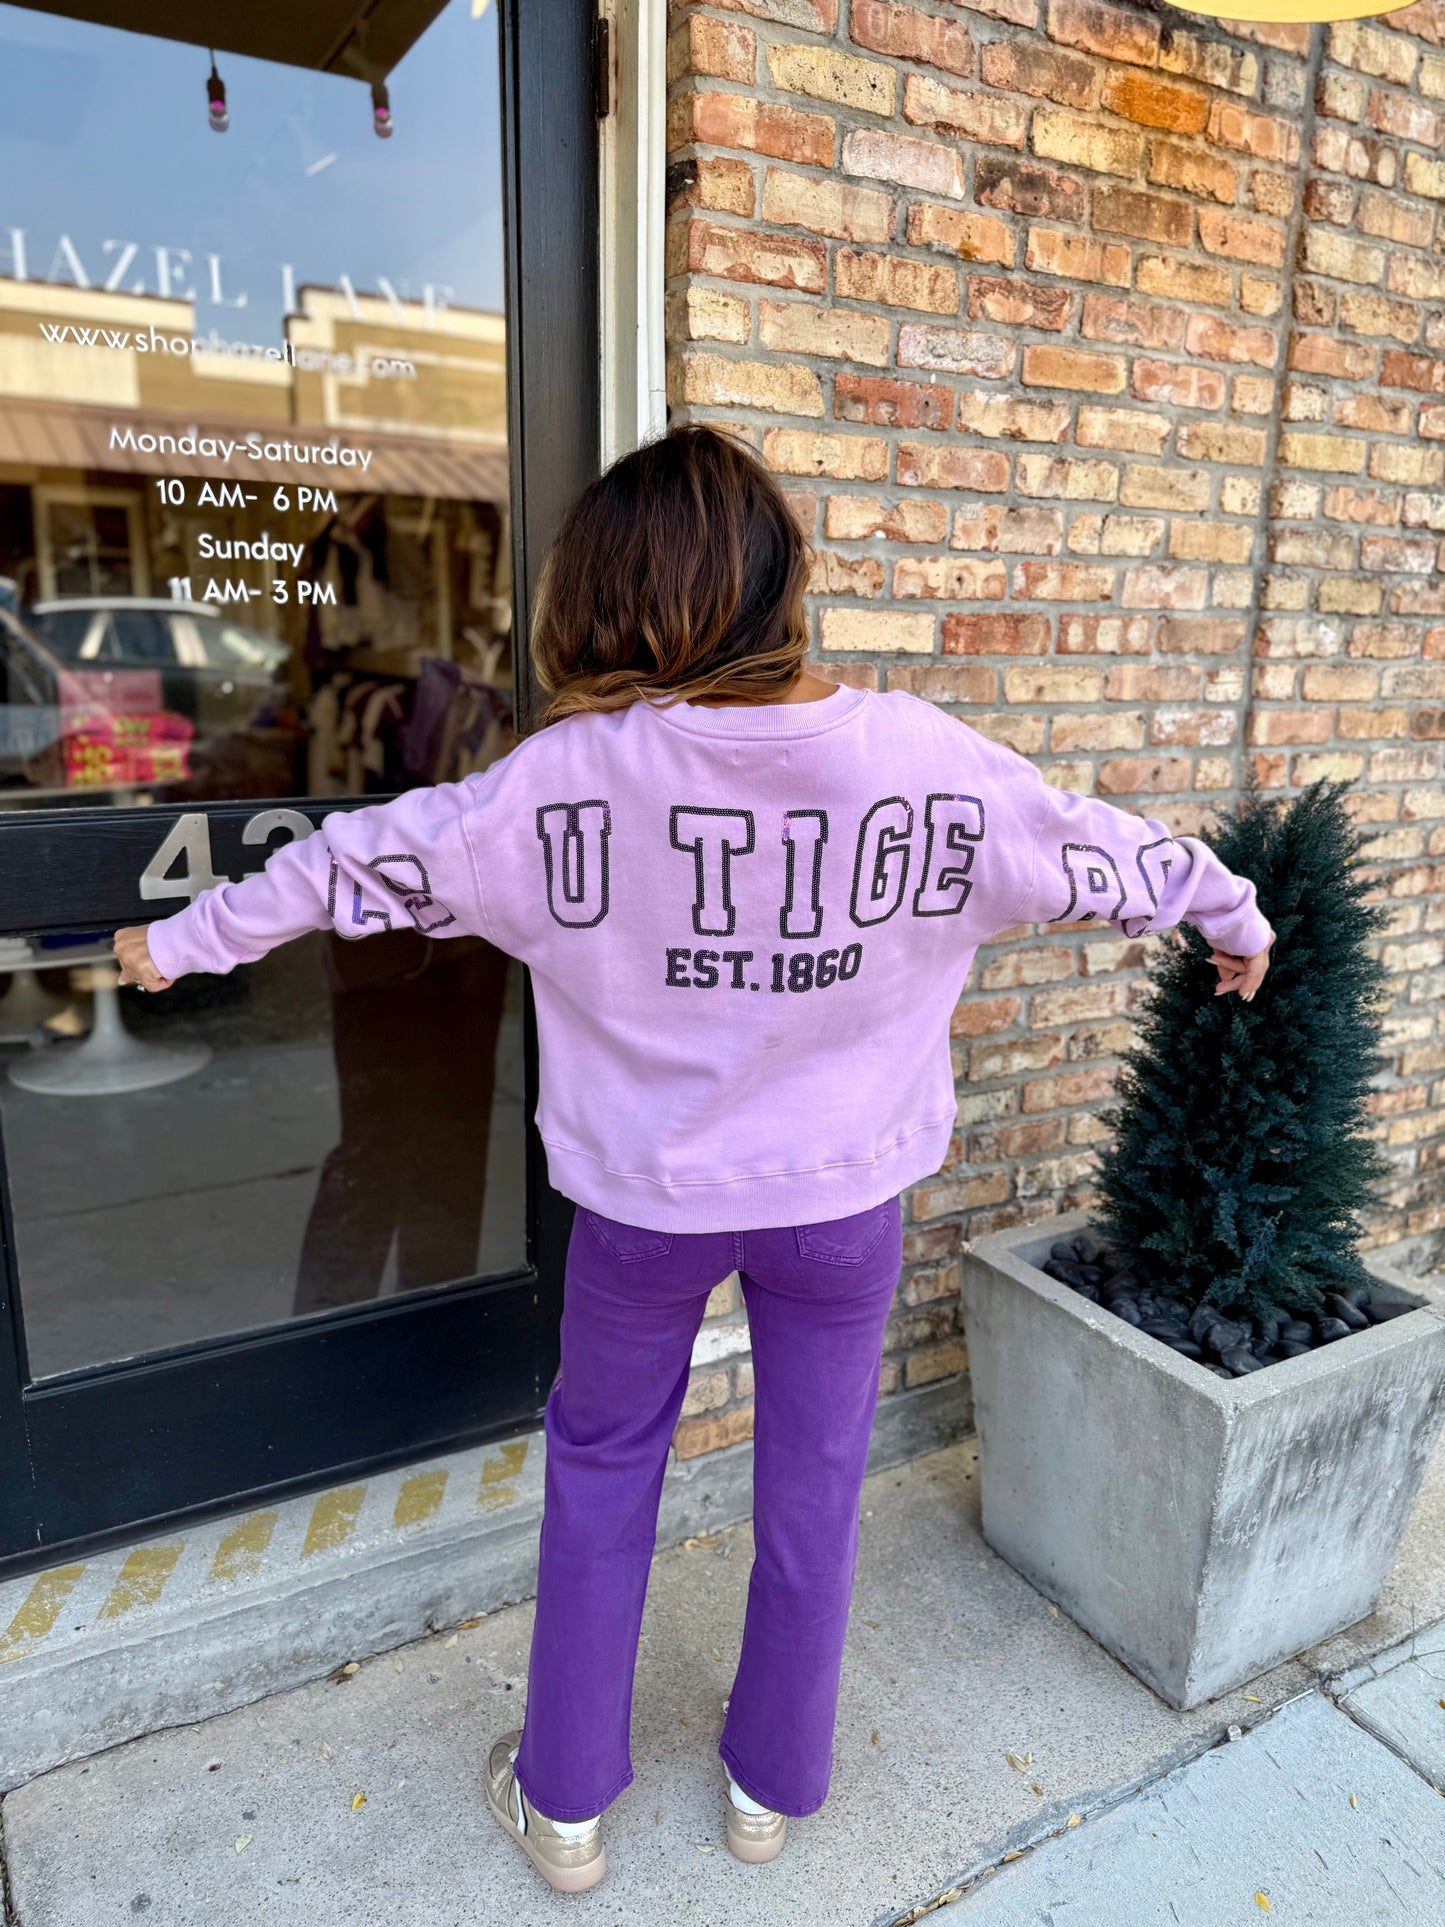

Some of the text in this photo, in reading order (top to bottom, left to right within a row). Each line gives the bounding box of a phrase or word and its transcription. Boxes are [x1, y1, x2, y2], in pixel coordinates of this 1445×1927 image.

[38, 322, 418, 382] www.shophazellane.om
[108, 424, 373, 472] Monday-Saturday
[156, 478, 186, 506] 10
[272, 486, 290, 512] 6
[297, 486, 338, 514] PM
[197, 530, 305, 568] Sunday
[167, 576, 192, 604] 11
[271, 580, 290, 605] 3
[297, 580, 337, 606] PM
[665, 942, 863, 994] EST. 1860
